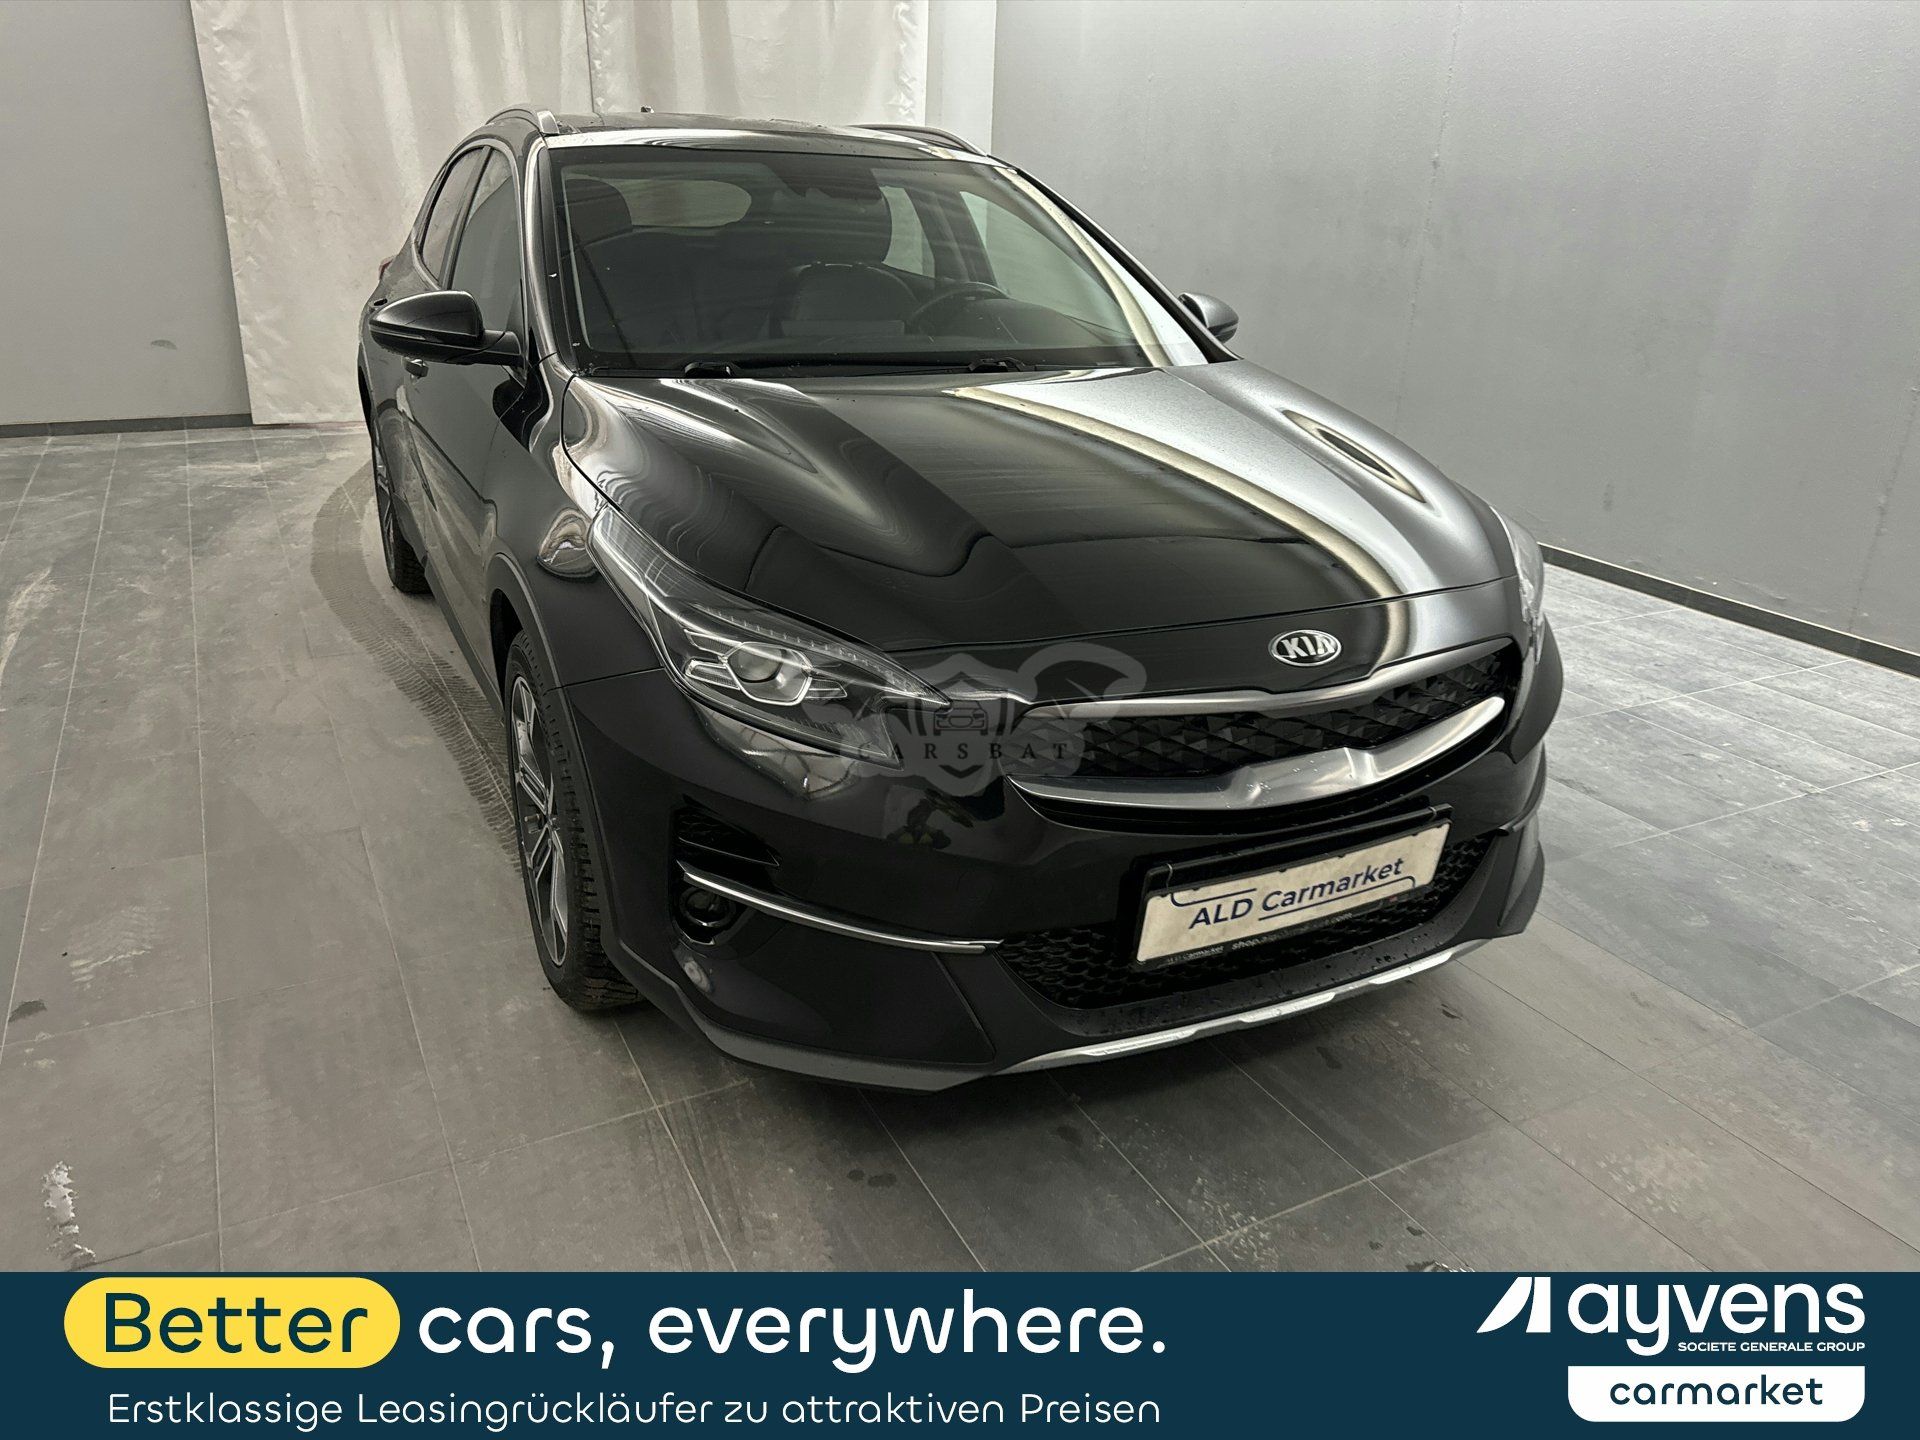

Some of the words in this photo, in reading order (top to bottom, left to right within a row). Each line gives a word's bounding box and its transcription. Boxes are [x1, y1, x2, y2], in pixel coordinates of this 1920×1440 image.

[1281, 635, 1335, 659] KIA
[1188, 898, 1253, 930] ALD
[1261, 858, 1404, 912] Carmarket
